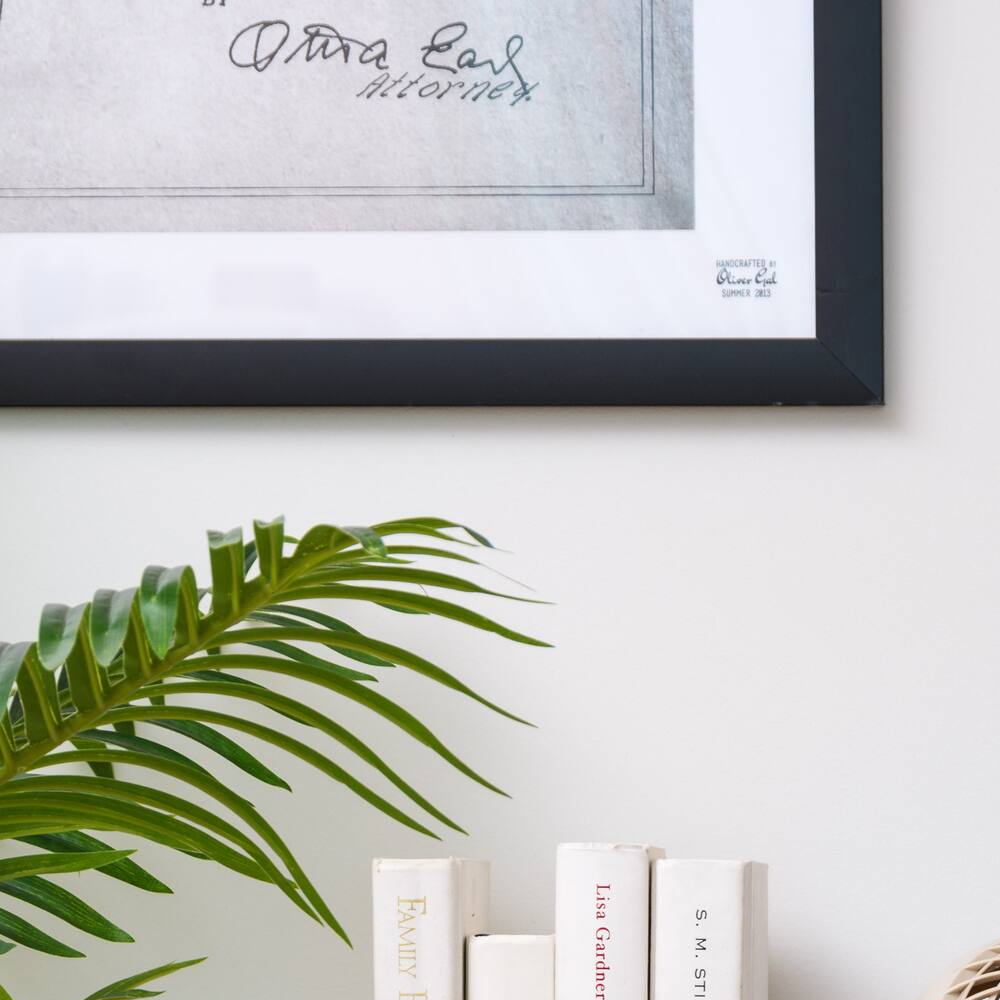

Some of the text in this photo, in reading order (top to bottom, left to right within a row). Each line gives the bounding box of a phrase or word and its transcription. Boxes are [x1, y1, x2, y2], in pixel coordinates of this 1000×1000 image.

[715, 259, 766, 268] HANDCRAFTED
[716, 267, 752, 285] Oliver
[721, 288, 771, 298] SUMMER 2013
[695, 909, 708, 928] S.
[595, 882, 611, 1000] Lisa Gardner
[694, 937, 707, 959] M.
